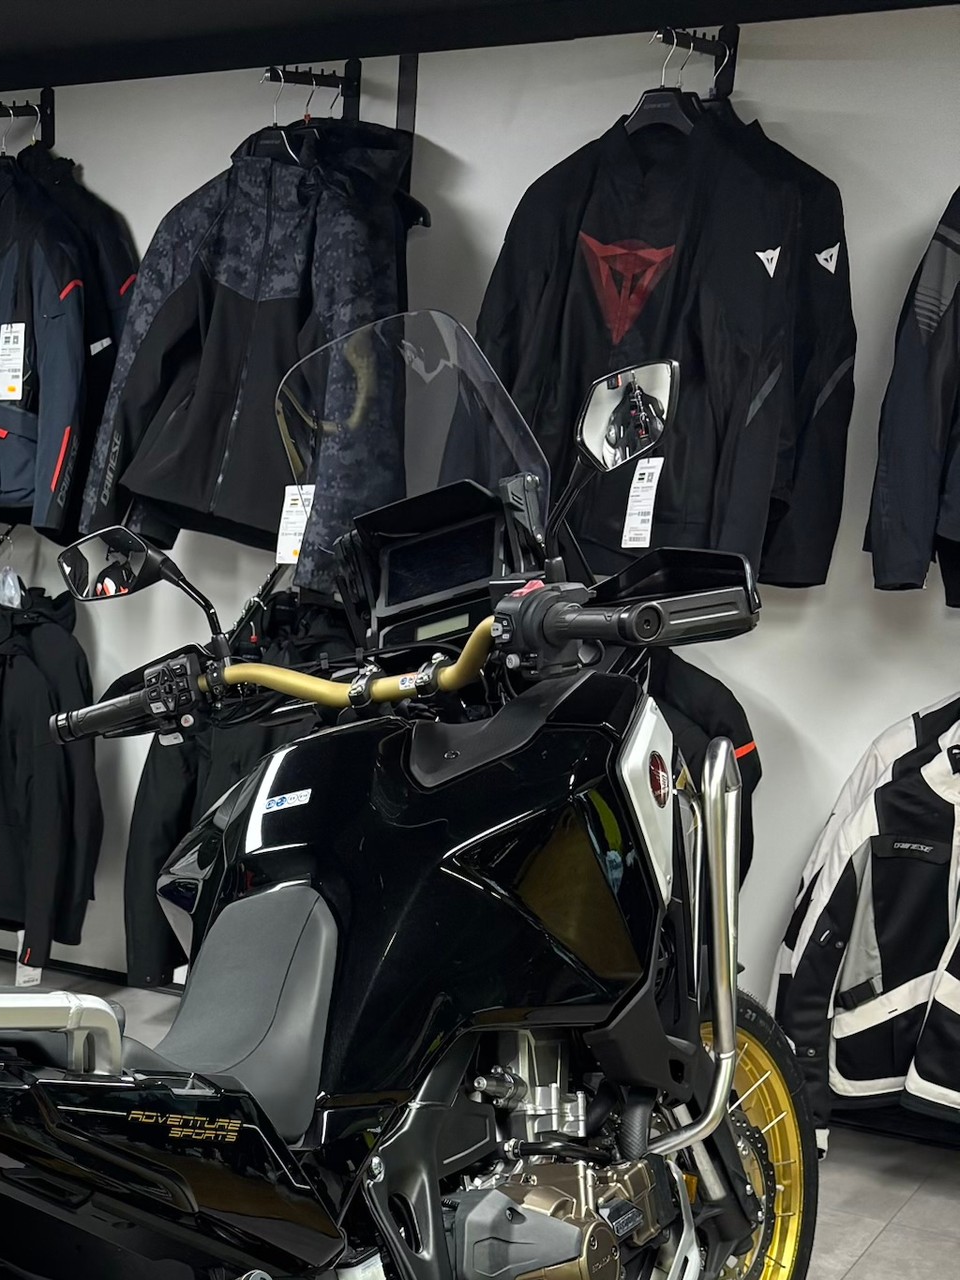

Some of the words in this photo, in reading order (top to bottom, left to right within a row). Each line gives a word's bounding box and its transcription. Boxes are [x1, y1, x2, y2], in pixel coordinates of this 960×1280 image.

[100, 430, 122, 506] DAINESE
[744, 1008, 757, 1022] 21
[128, 1110, 242, 1130] ADVENTURE
[168, 1127, 238, 1142] SPORTS
